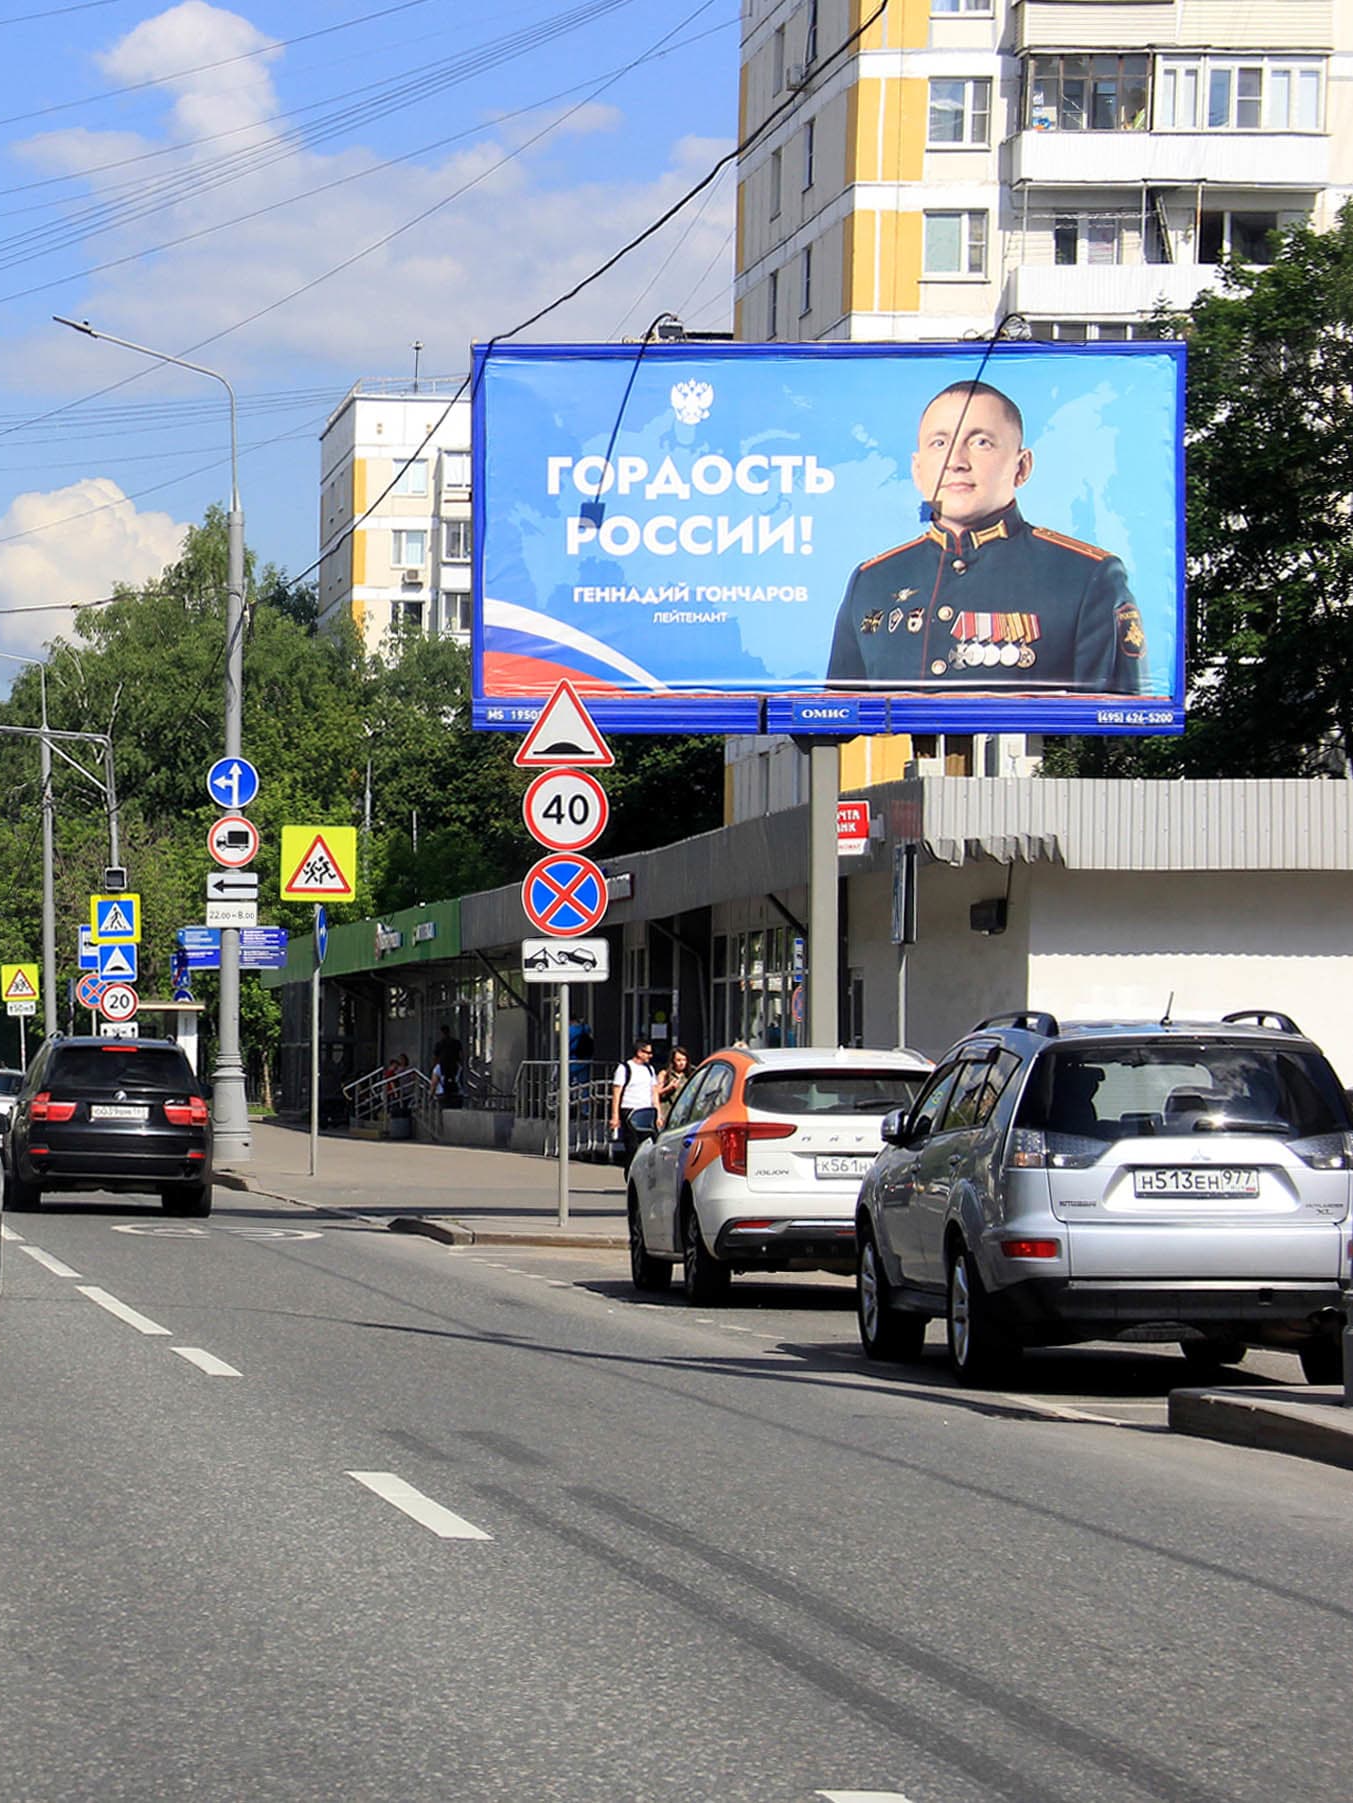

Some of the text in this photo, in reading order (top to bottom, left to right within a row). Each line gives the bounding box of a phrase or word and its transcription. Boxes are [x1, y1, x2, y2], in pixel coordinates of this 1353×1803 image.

[547, 455, 836, 500] ГОРДОСТЬ
[566, 514, 814, 556] РОССИИ!
[573, 582, 808, 604] ГЕННАДИЙ ГОНЧАРОВ
[653, 610, 728, 623] ЛЕЙТЕНАНТ
[487, 709, 504, 720] MS
[801, 708, 850, 719] ОМИС
[542, 794, 589, 825] 40
[837, 809, 860, 820] ЧТА
[109, 994, 130, 1009] 20
[1142, 1169, 1252, 1190] Н513ЕН 977
